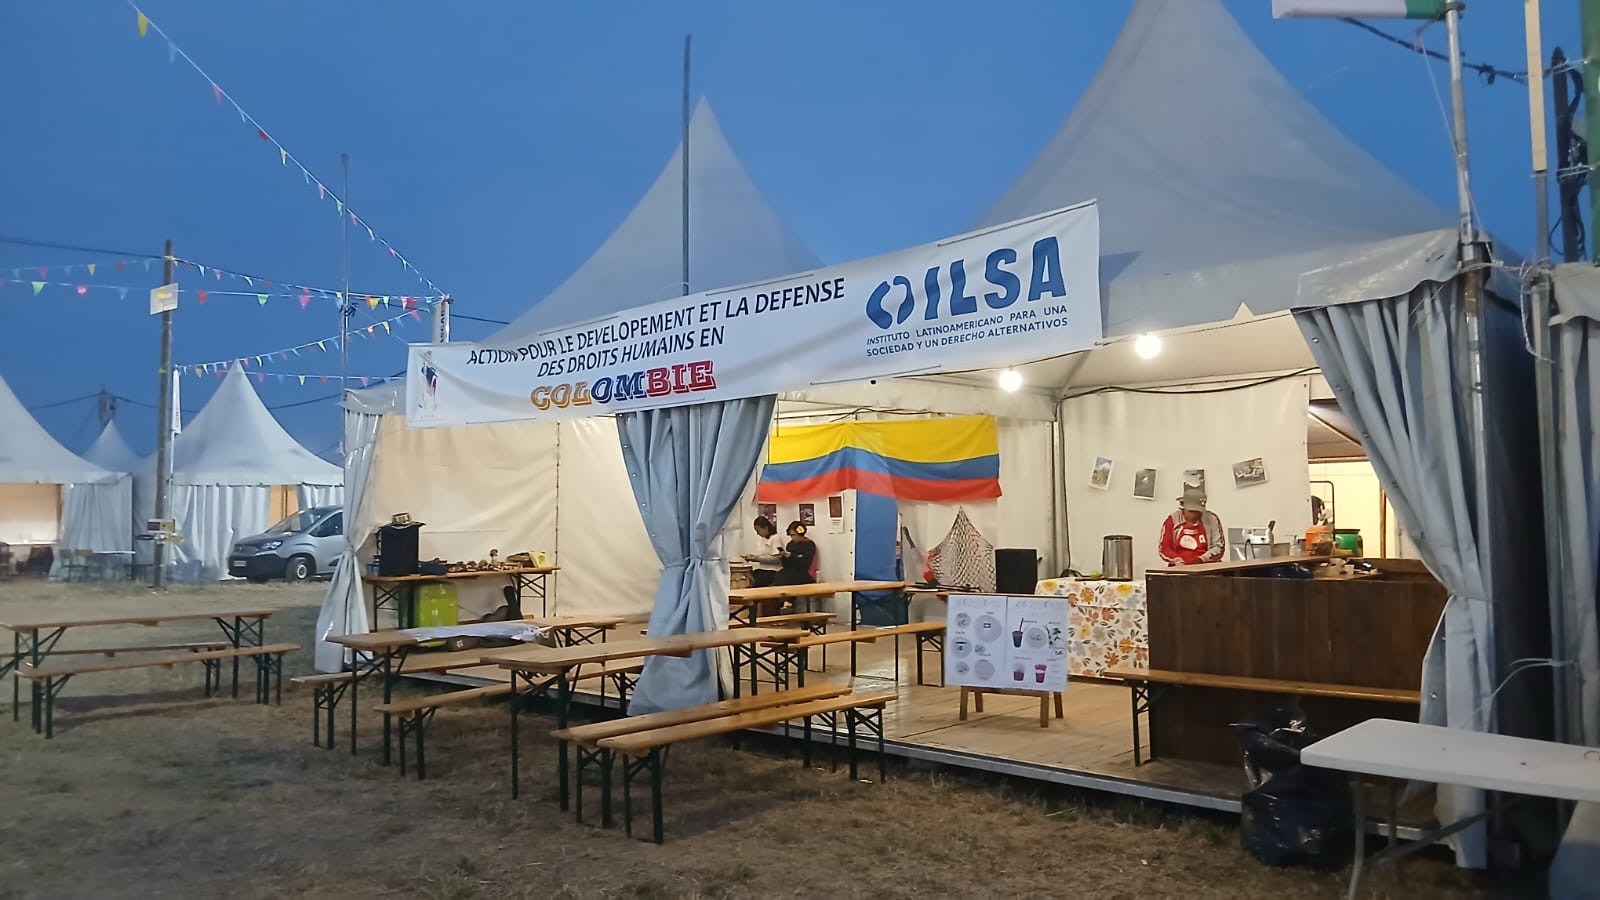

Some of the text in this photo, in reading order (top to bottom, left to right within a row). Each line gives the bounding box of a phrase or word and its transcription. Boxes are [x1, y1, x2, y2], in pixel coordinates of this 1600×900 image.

[466, 277, 845, 365] ACTION POUR LE DEVELOPEMENT ET LA DEFENSE
[866, 304, 1068, 346] INSTITUTO LATINOAMERICANO PARA UNA
[866, 317, 1068, 357] SOCIEDAD Y UN DERECHO ALTERNATIVOS
[537, 325, 725, 378] DES DROITS HUMAINS EN
[530, 360, 717, 411] COLOMBIE
